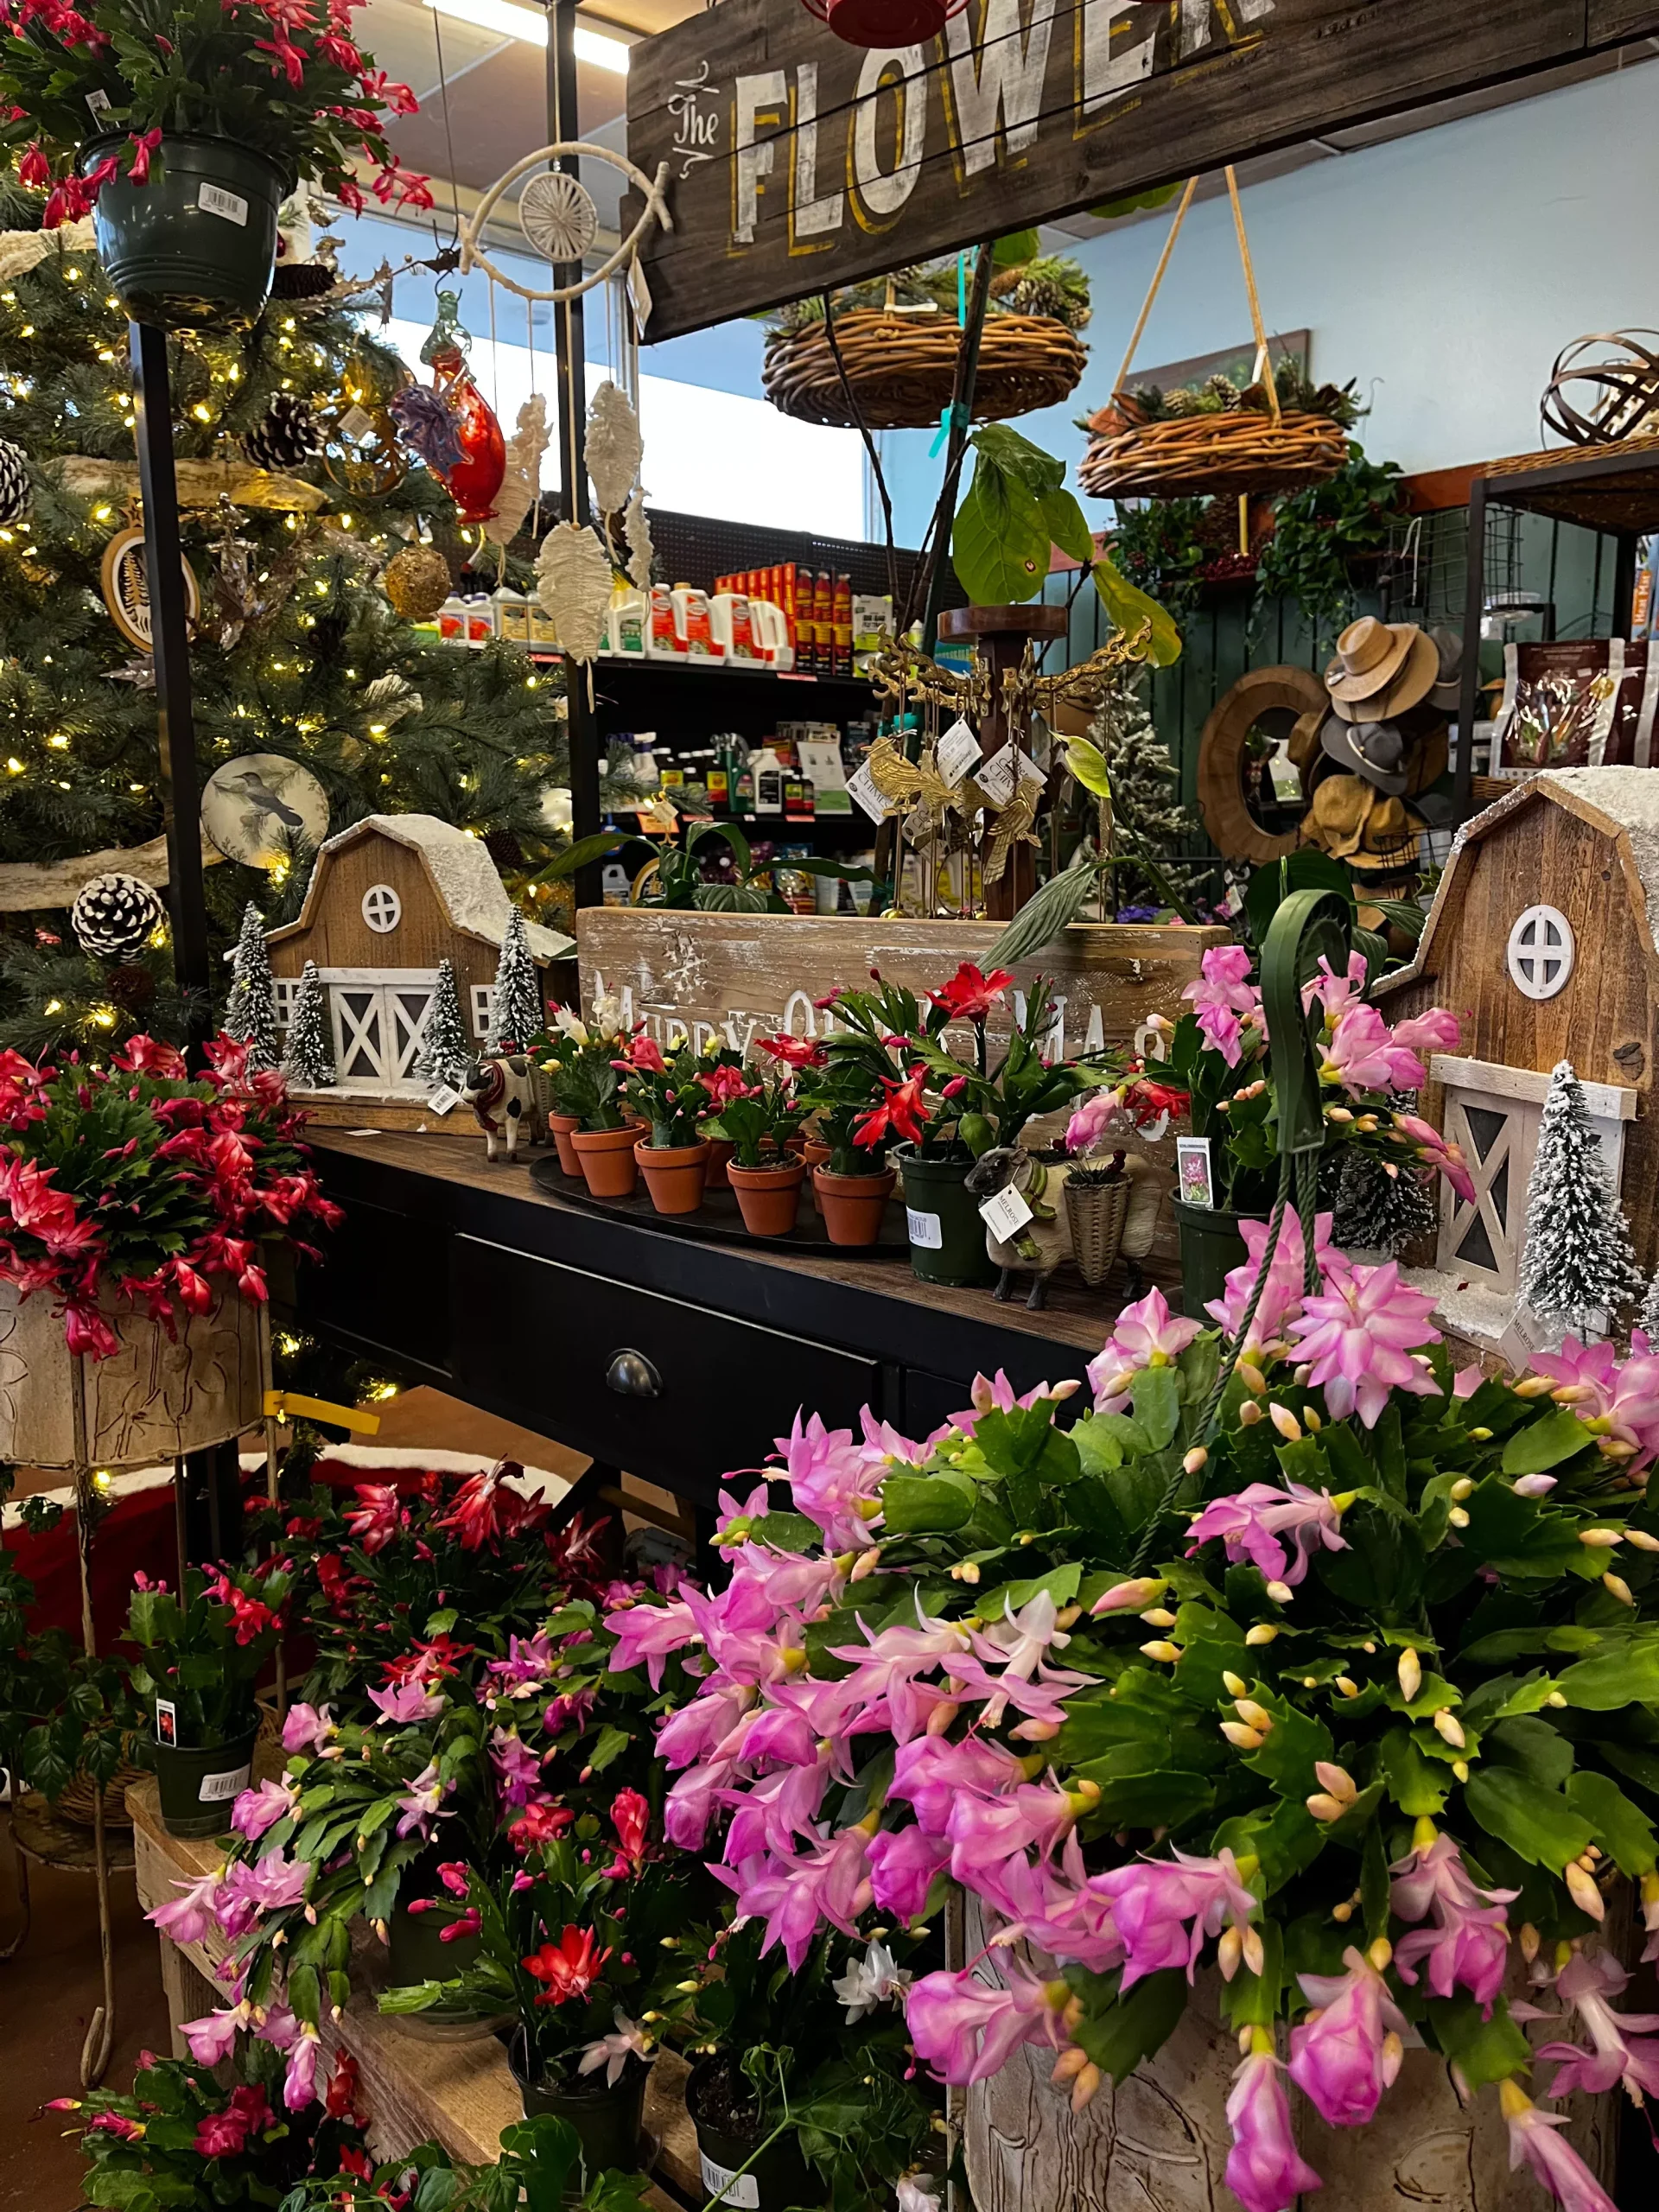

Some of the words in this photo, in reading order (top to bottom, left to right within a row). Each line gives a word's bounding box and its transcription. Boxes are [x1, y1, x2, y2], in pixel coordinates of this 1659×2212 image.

[668, 93, 720, 144] The
[858, 772, 891, 810] CHIMES
[989, 763, 1018, 794] CHIM
[998, 1194, 1020, 1227] MELROSE
[1513, 1319, 1535, 1352] MELROSE
